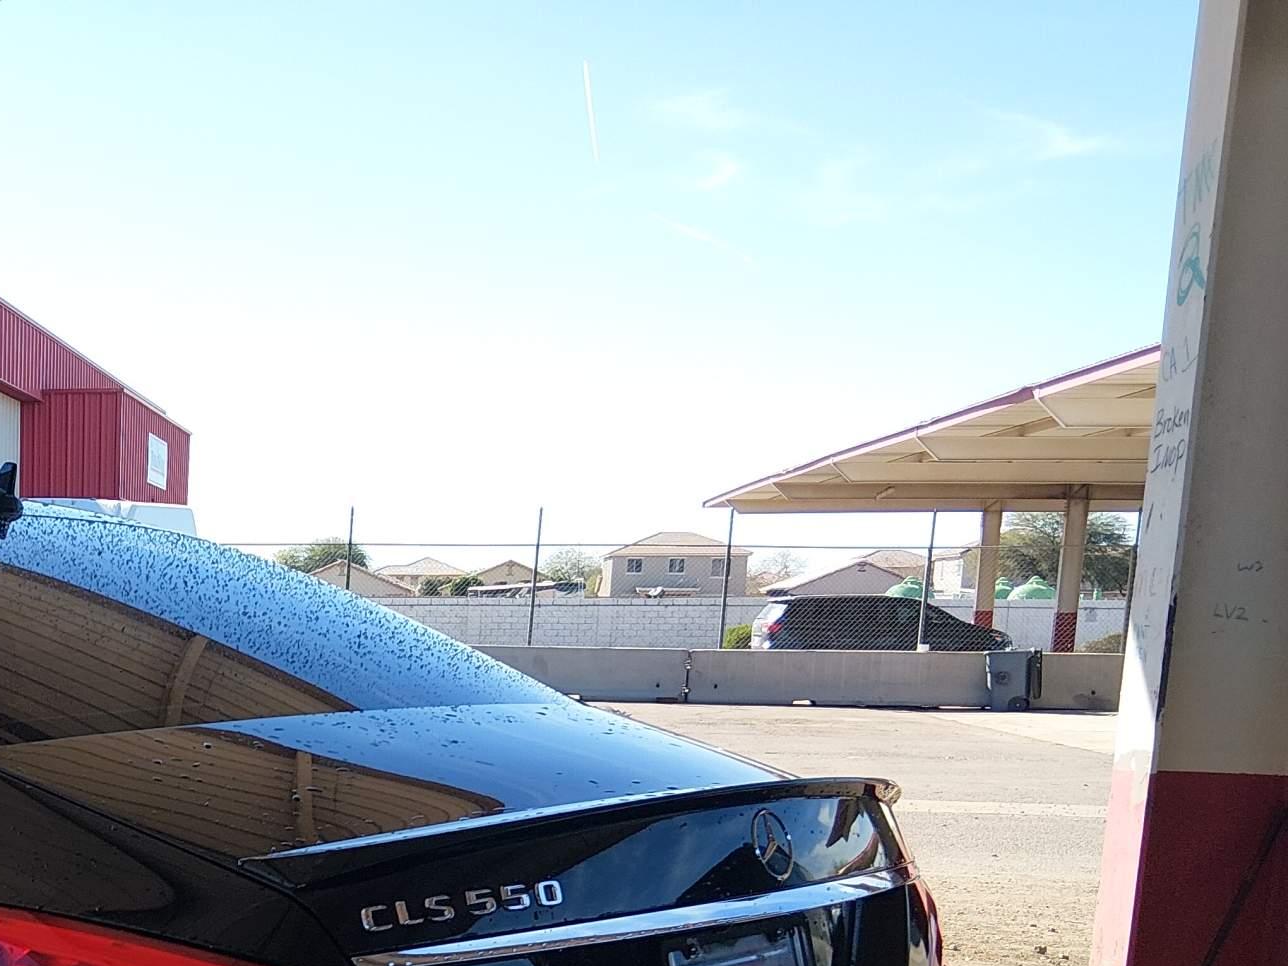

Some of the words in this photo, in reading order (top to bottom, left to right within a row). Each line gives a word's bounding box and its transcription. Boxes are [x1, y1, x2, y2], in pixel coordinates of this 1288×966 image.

[1154, 405, 1190, 439] Broken
[361, 894, 455, 932] CLS
[464, 880, 563, 915] 550
